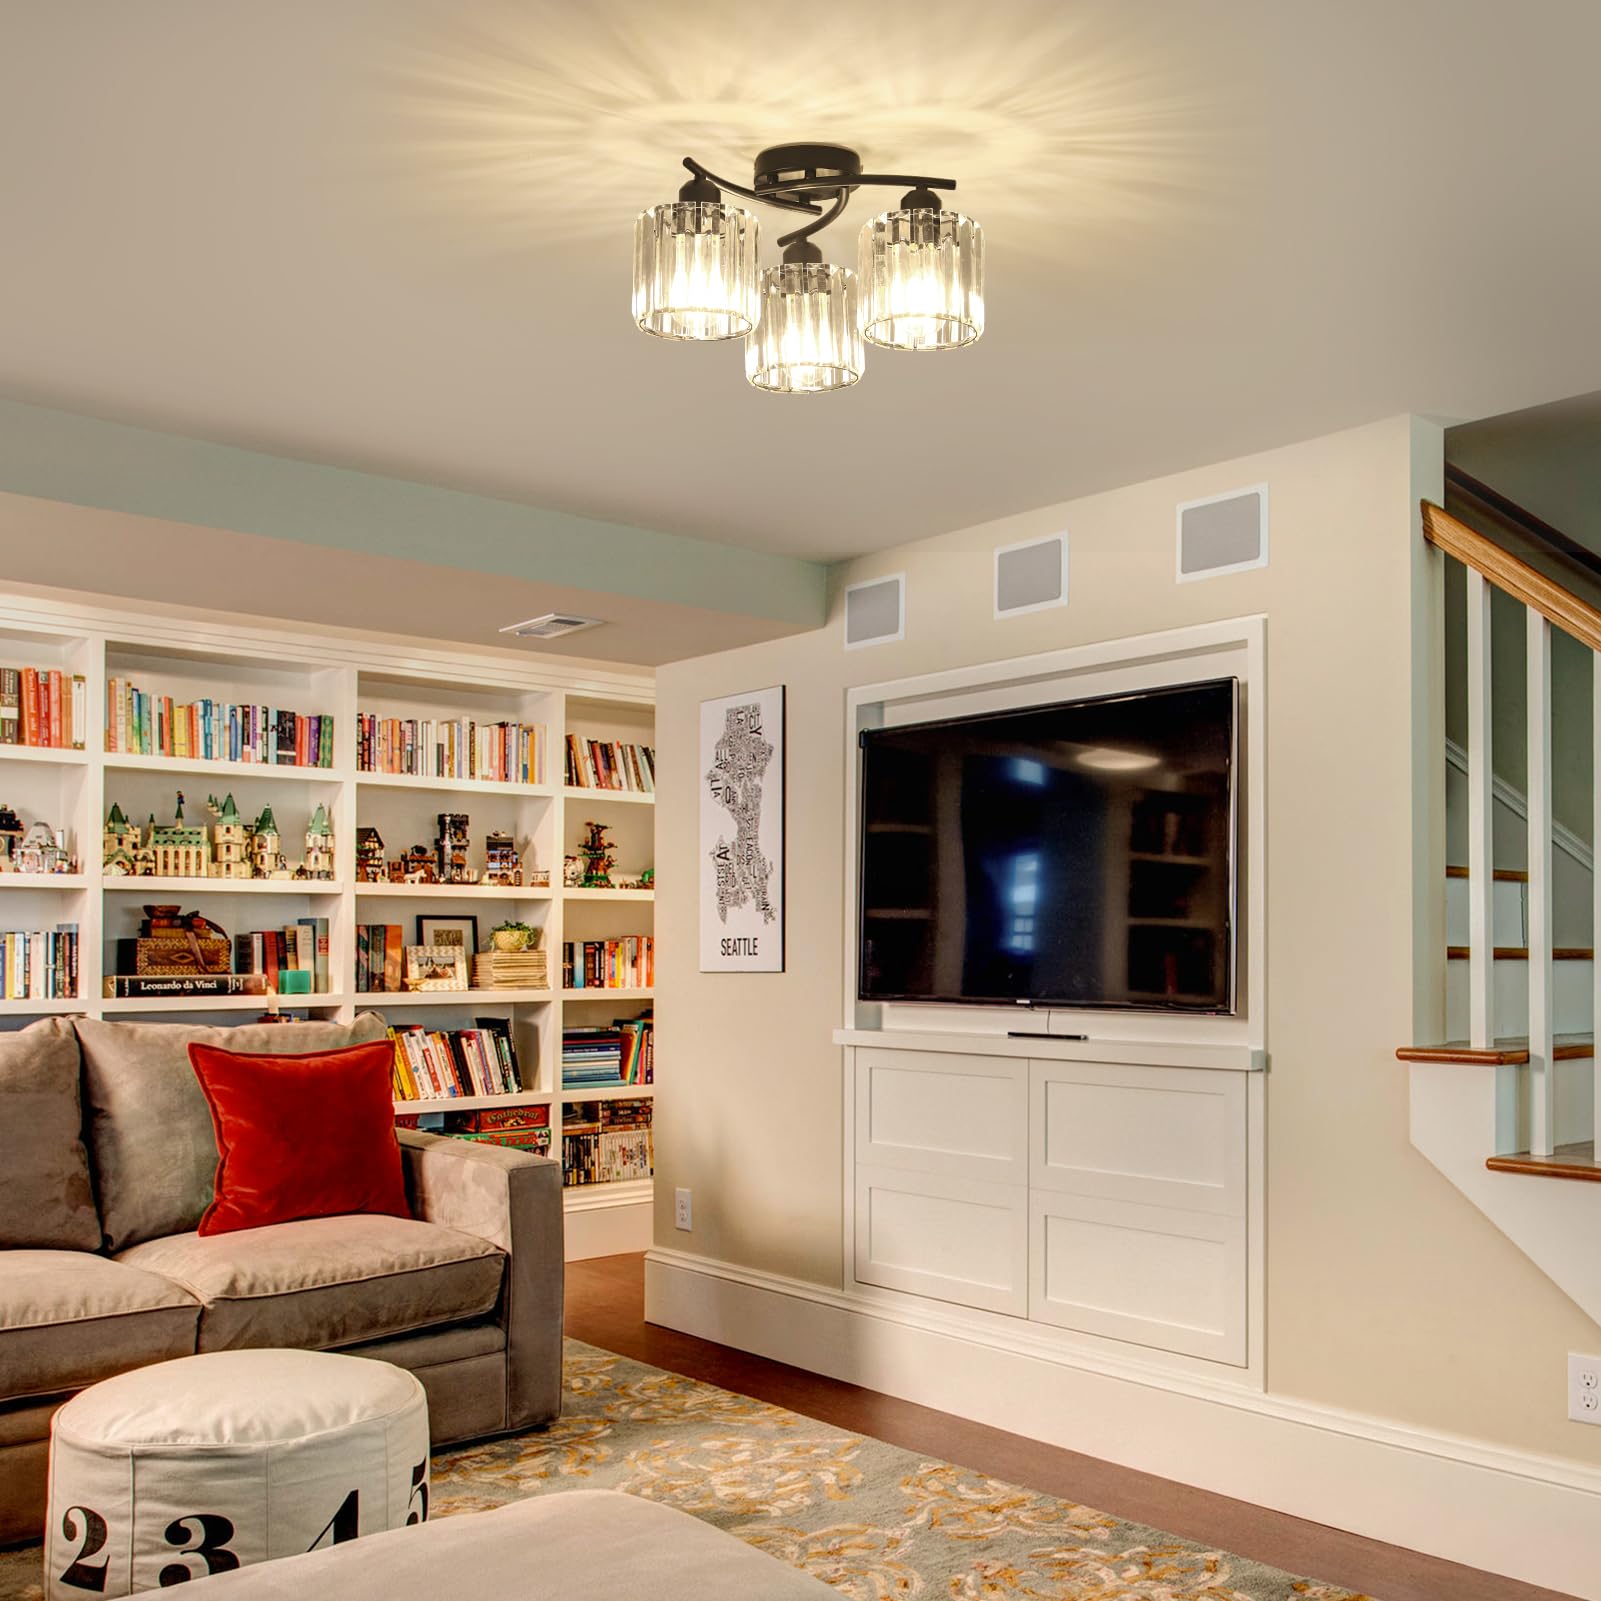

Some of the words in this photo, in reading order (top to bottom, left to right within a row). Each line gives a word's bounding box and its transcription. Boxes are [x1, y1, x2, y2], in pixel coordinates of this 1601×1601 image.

[720, 937, 759, 957] SEATTLE
[140, 981, 182, 991] Leonardo
[183, 980, 194, 990] da
[195, 980, 218, 989] Vinci
[487, 1108, 539, 1124] Cathedral
[59, 1505, 111, 1593] 2
[159, 1513, 241, 1588] 3
